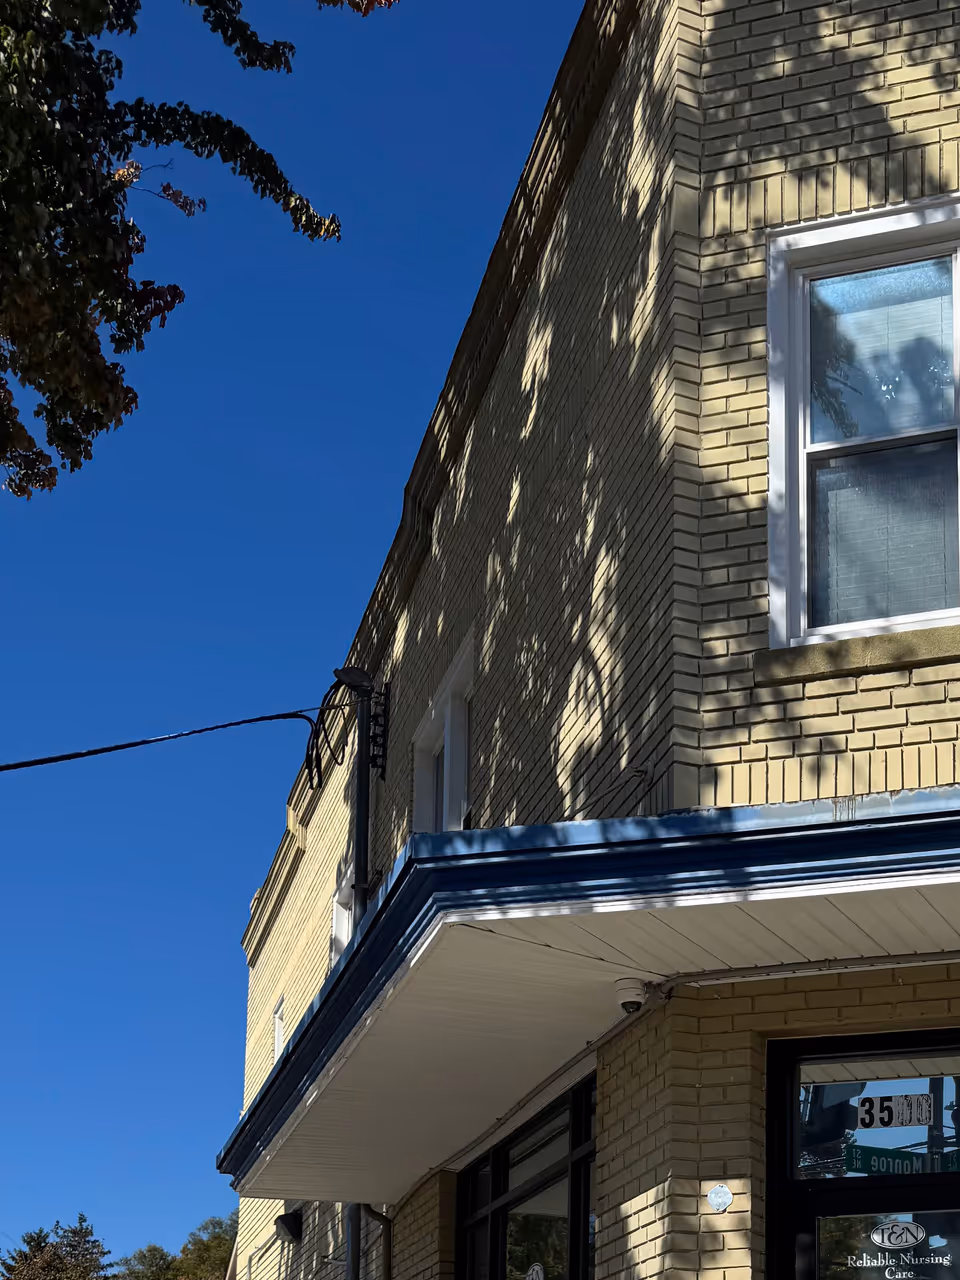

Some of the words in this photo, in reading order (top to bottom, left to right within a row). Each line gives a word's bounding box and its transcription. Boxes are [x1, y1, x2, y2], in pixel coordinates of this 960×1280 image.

[878, 1222, 920, 1246] T&N
[847, 1253, 896, 1268] Reliable
[900, 1253, 951, 1267] Nursing
[885, 1267, 914, 1280] Care
